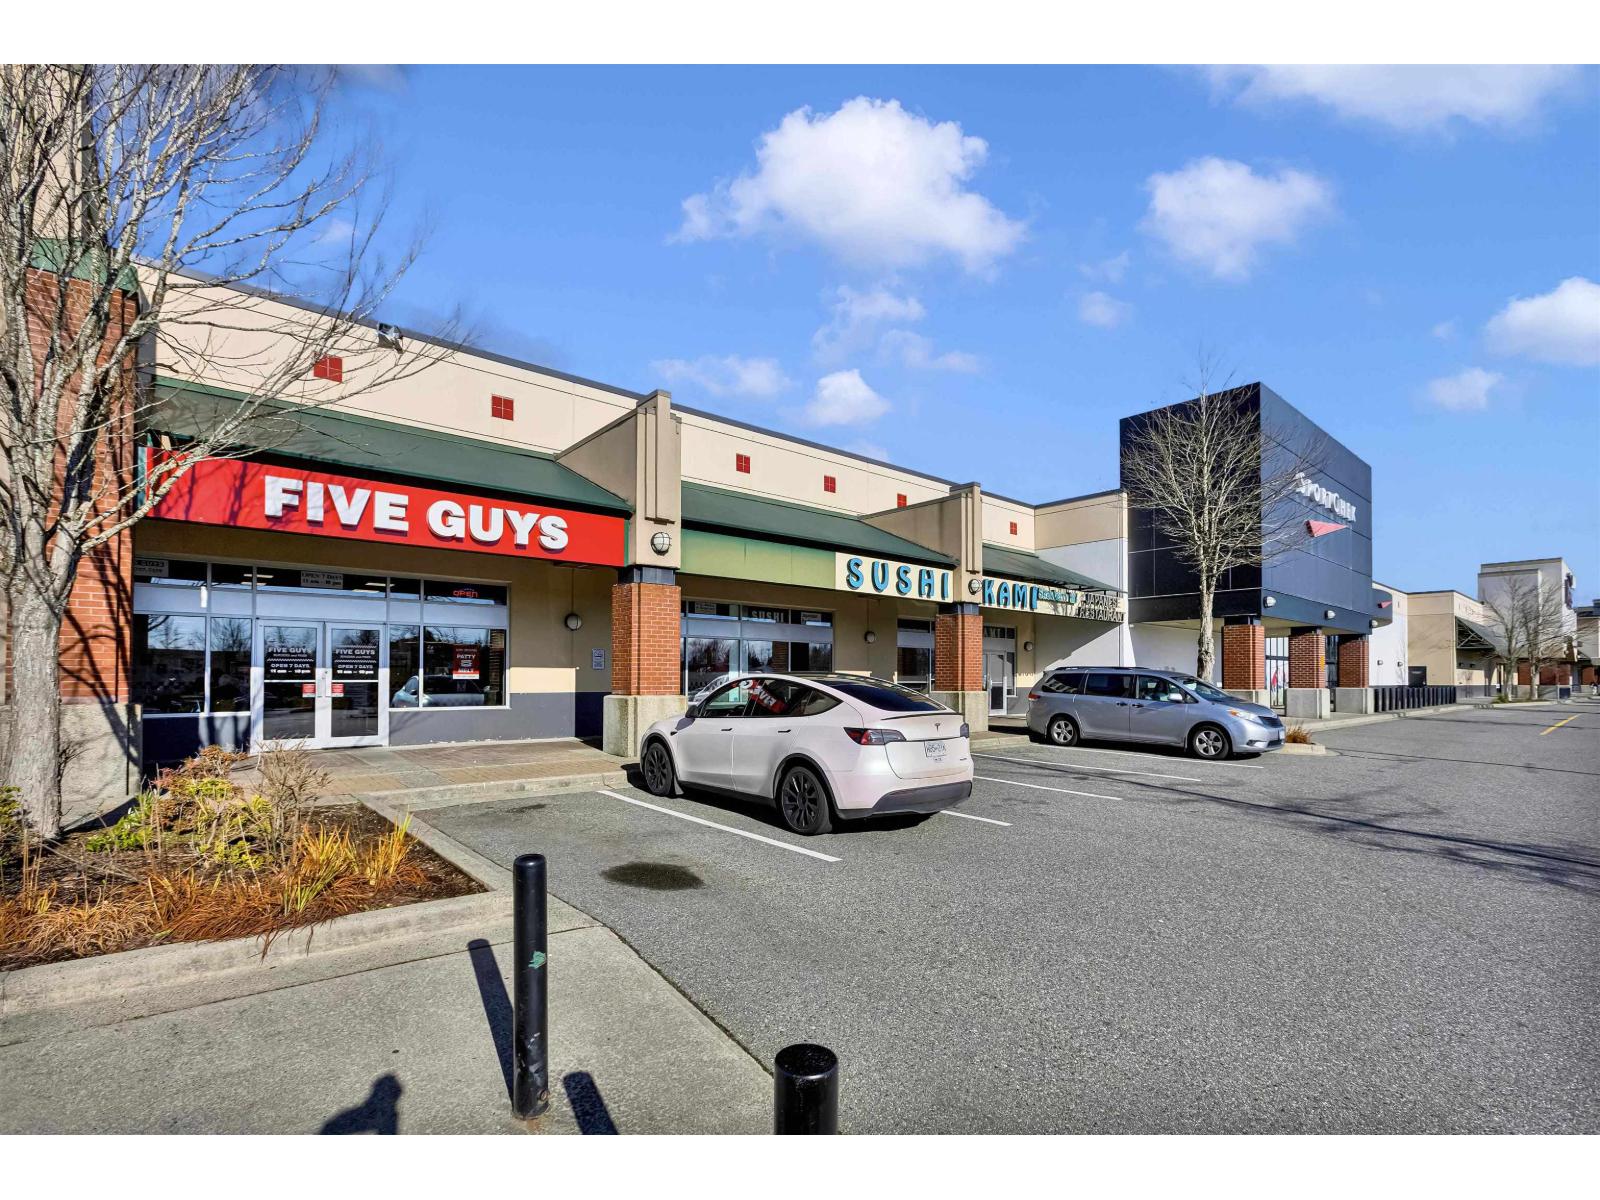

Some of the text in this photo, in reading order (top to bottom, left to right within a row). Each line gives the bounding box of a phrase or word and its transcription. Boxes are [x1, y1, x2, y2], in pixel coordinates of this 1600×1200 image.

[264, 475, 569, 550] FIVE GUYS
[846, 558, 1038, 611] SUSHI KAMI
[752, 611, 784, 622] SUSHI
